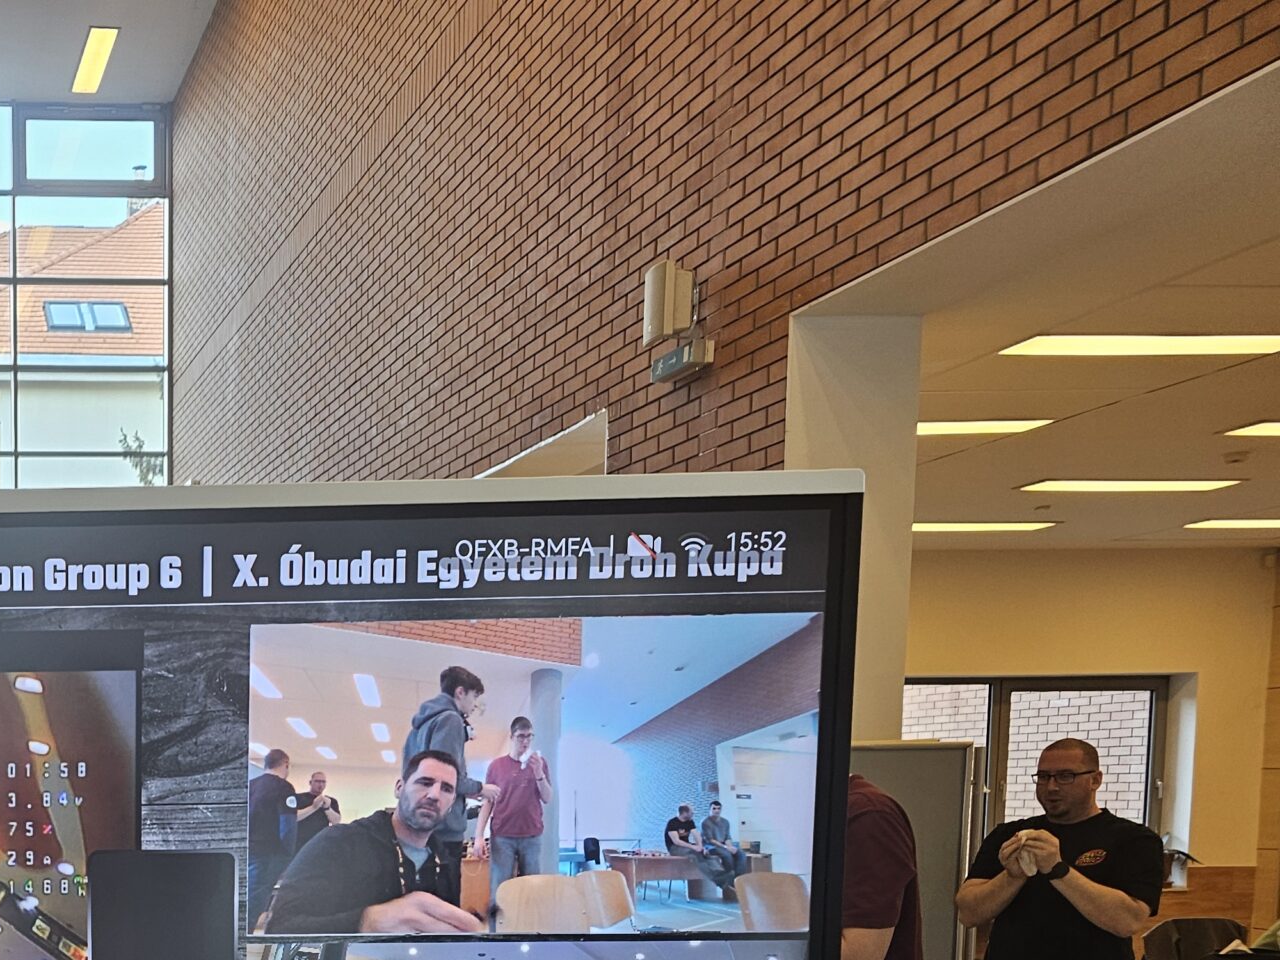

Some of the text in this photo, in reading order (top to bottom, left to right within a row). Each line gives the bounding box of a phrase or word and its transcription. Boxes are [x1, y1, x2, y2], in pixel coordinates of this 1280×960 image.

[726, 530, 787, 553] 15:52
[44, 557, 150, 596] Group
[160, 555, 182, 590] 6
[232, 553, 269, 587] X.
[279, 543, 407, 587] Óbudai
[417, 549, 578, 589] Egyetem
[687, 543, 784, 582] Kupa
